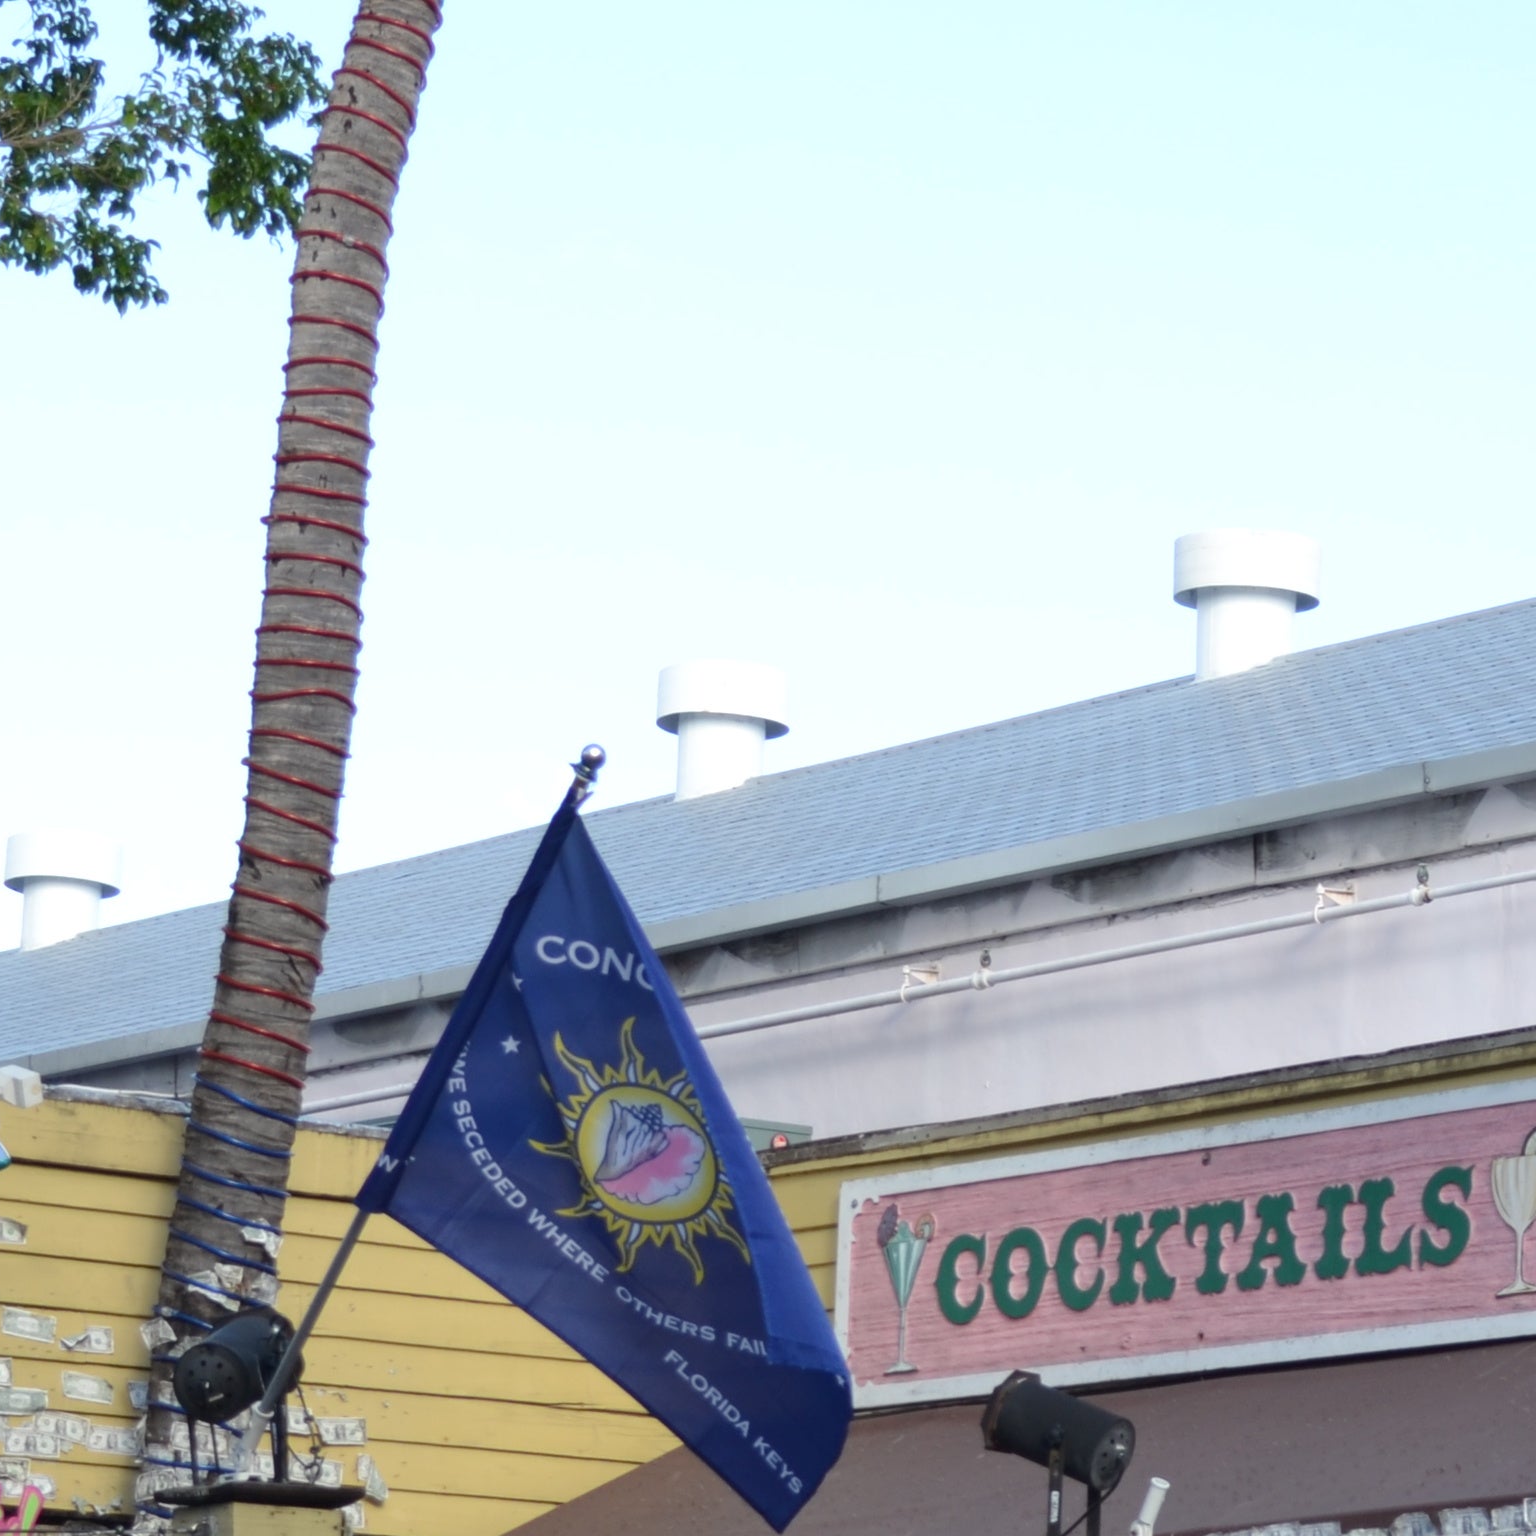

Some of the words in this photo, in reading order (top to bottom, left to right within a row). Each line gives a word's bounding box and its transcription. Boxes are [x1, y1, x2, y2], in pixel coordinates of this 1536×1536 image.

[452, 1099, 527, 1210] SECEDED
[527, 1209, 610, 1283] WHERE
[615, 1286, 715, 1342] OTHERS
[935, 1165, 1476, 1326] COCKTAILS
[664, 1349, 751, 1438] FLORIDA
[754, 1436, 804, 1495] KEYS
